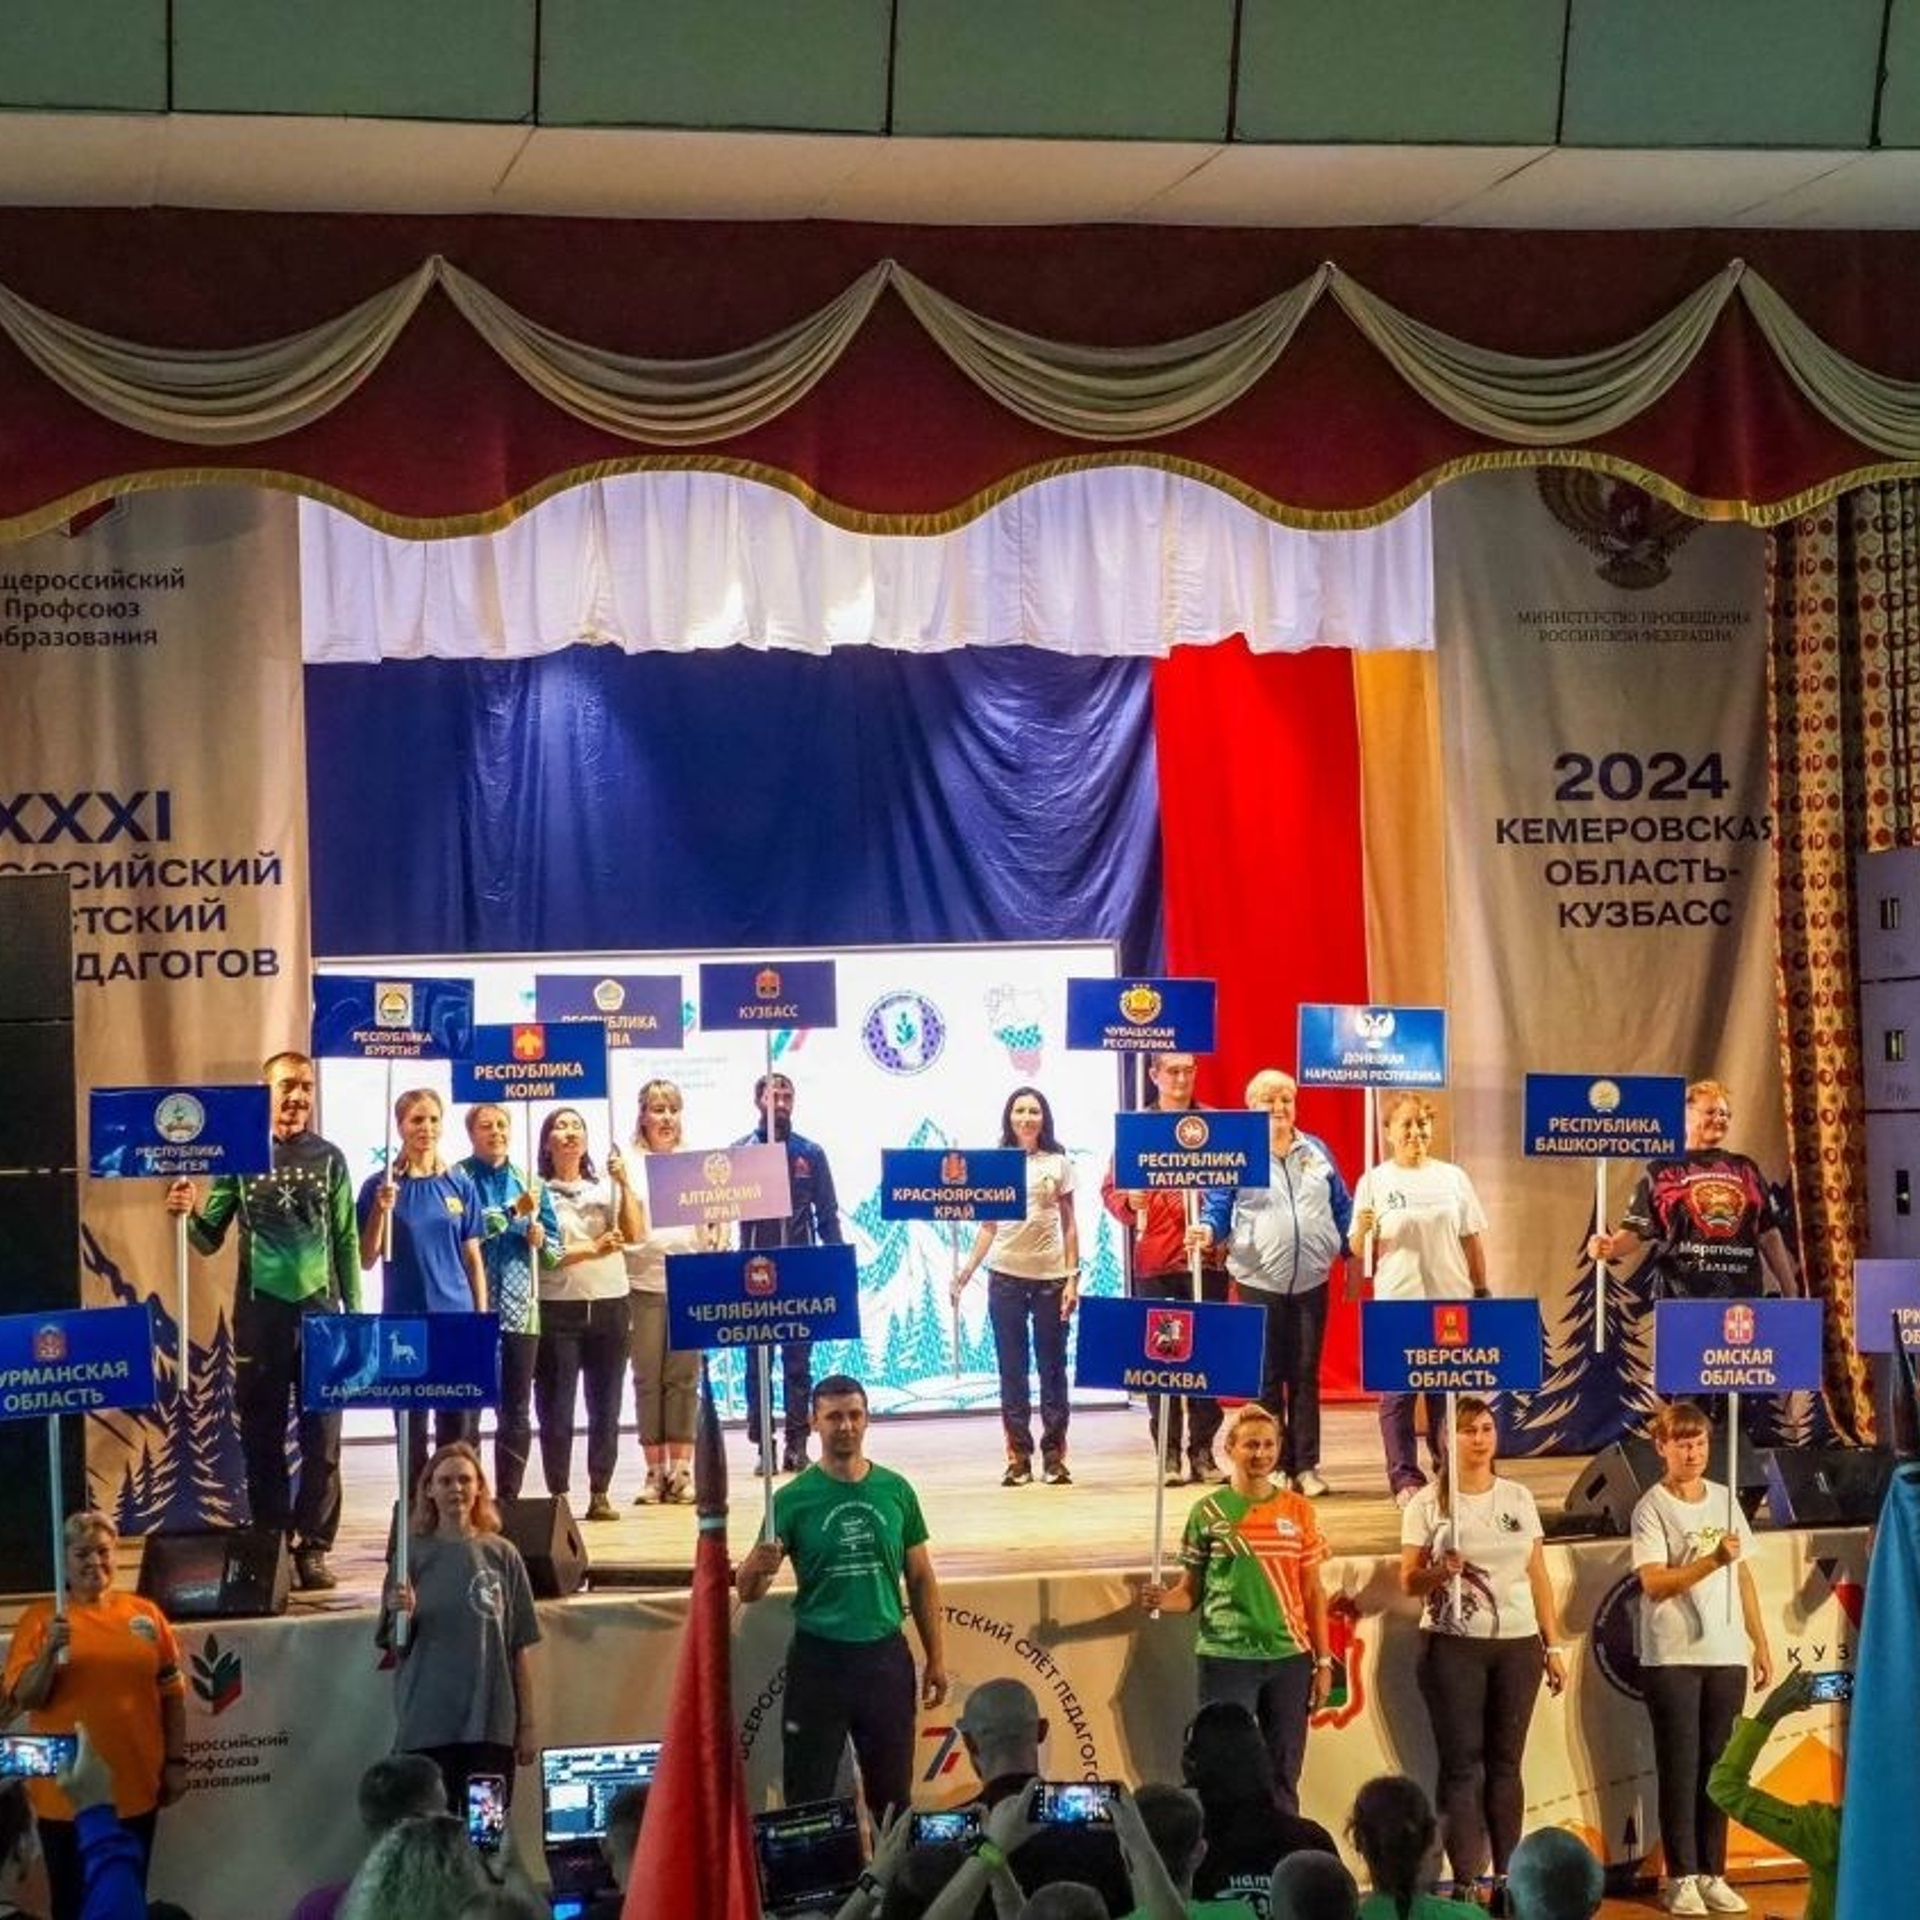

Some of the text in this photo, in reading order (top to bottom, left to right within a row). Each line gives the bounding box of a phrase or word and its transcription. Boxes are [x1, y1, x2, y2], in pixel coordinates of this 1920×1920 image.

[4, 597, 140, 623] Профсоюз
[0, 625, 158, 651] бразования
[1553, 752, 1730, 801] 2024
[74, 897, 227, 935] ТСКИЙ
[1558, 900, 1732, 928] КУЗБАСС
[75, 949, 280, 987] ДАГОГОВ
[739, 1004, 799, 1019] КУЗБАСС
[352, 1031, 433, 1043] РЕСПУБЛИКА
[1102, 1038, 1177, 1050] РЕСПУБЛИКА
[364, 1044, 421, 1056] БУРЯТИЯ
[474, 1062, 584, 1081] РЕСПУБЛИКА
[1305, 1068, 1368, 1083] НАРОДНАЯ
[505, 1082, 556, 1099] КОМИ
[1549, 1117, 1662, 1134] РЕСПУБЛИКА
[135, 1145, 225, 1159] РЕСПУБЛИКА
[1534, 1137, 1675, 1154] БАШКОРТОСТАН
[1138, 1151, 1247, 1168] РЕСПУБЛИКА
[1146, 1171, 1239, 1186] ТАТАРСТАН
[678, 1182, 763, 1206] АЛТАЙСКИЙ
[892, 1187, 1016, 1202] КРАСНОЯРСКИЙ
[933, 1203, 975, 1219] КРАЙ
[688, 1297, 837, 1323] ЧЕЛЯБИНСКАЯ
[717, 1322, 811, 1344] ОБЛАСТЬ
[1404, 1347, 1501, 1366] ТВЕРСКАЯ
[1703, 1349, 1774, 1366] ОМСКАЯ
[1123, 1369, 1208, 1391] МОСКВА
[1408, 1369, 1499, 1388] ОБЛАСТЬ
[1701, 1368, 1777, 1386] ОБЛАСТЬ
[414, 1384, 485, 1397] ОБЛАСТЬ
[3, 1388, 105, 1413] ОБЛАСТЬ
[940, 1605, 1101, 1783] ТСКИЙ СЛЁТ ПЕДАГОГО
